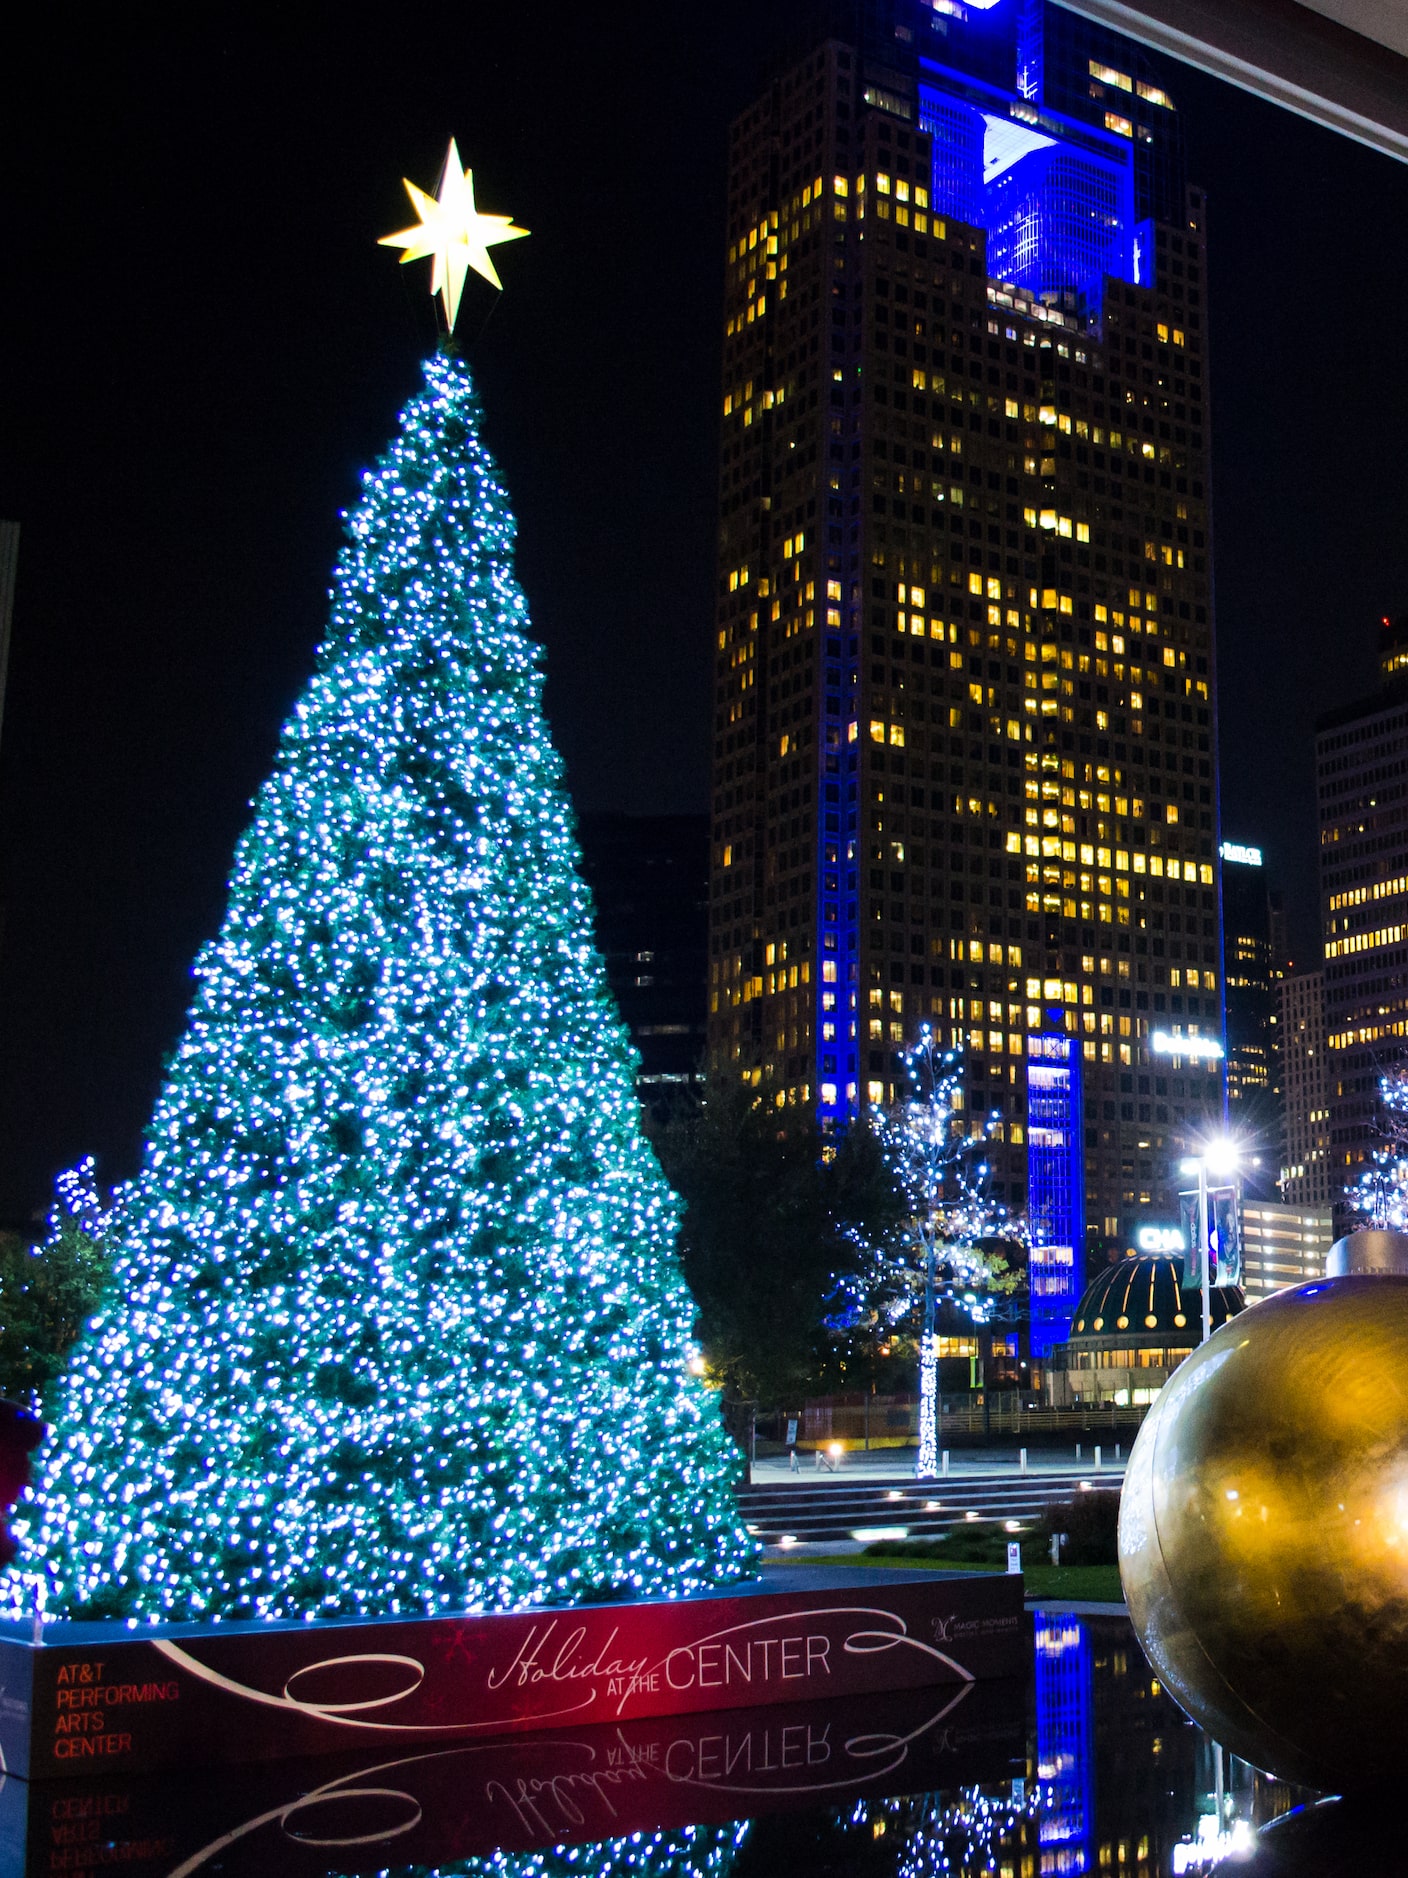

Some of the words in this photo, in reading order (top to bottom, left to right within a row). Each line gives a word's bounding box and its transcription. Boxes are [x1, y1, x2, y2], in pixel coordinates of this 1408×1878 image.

[56, 1663, 105, 1685] AT&T
[488, 1619, 648, 1716] Holiday
[606, 1677, 625, 1697] AT
[630, 1673, 660, 1693] THE
[666, 1635, 832, 1690] CENTER
[56, 1681, 180, 1709] PERFORMING
[55, 1711, 105, 1734] ARTS
[54, 1732, 132, 1759] CENTER
